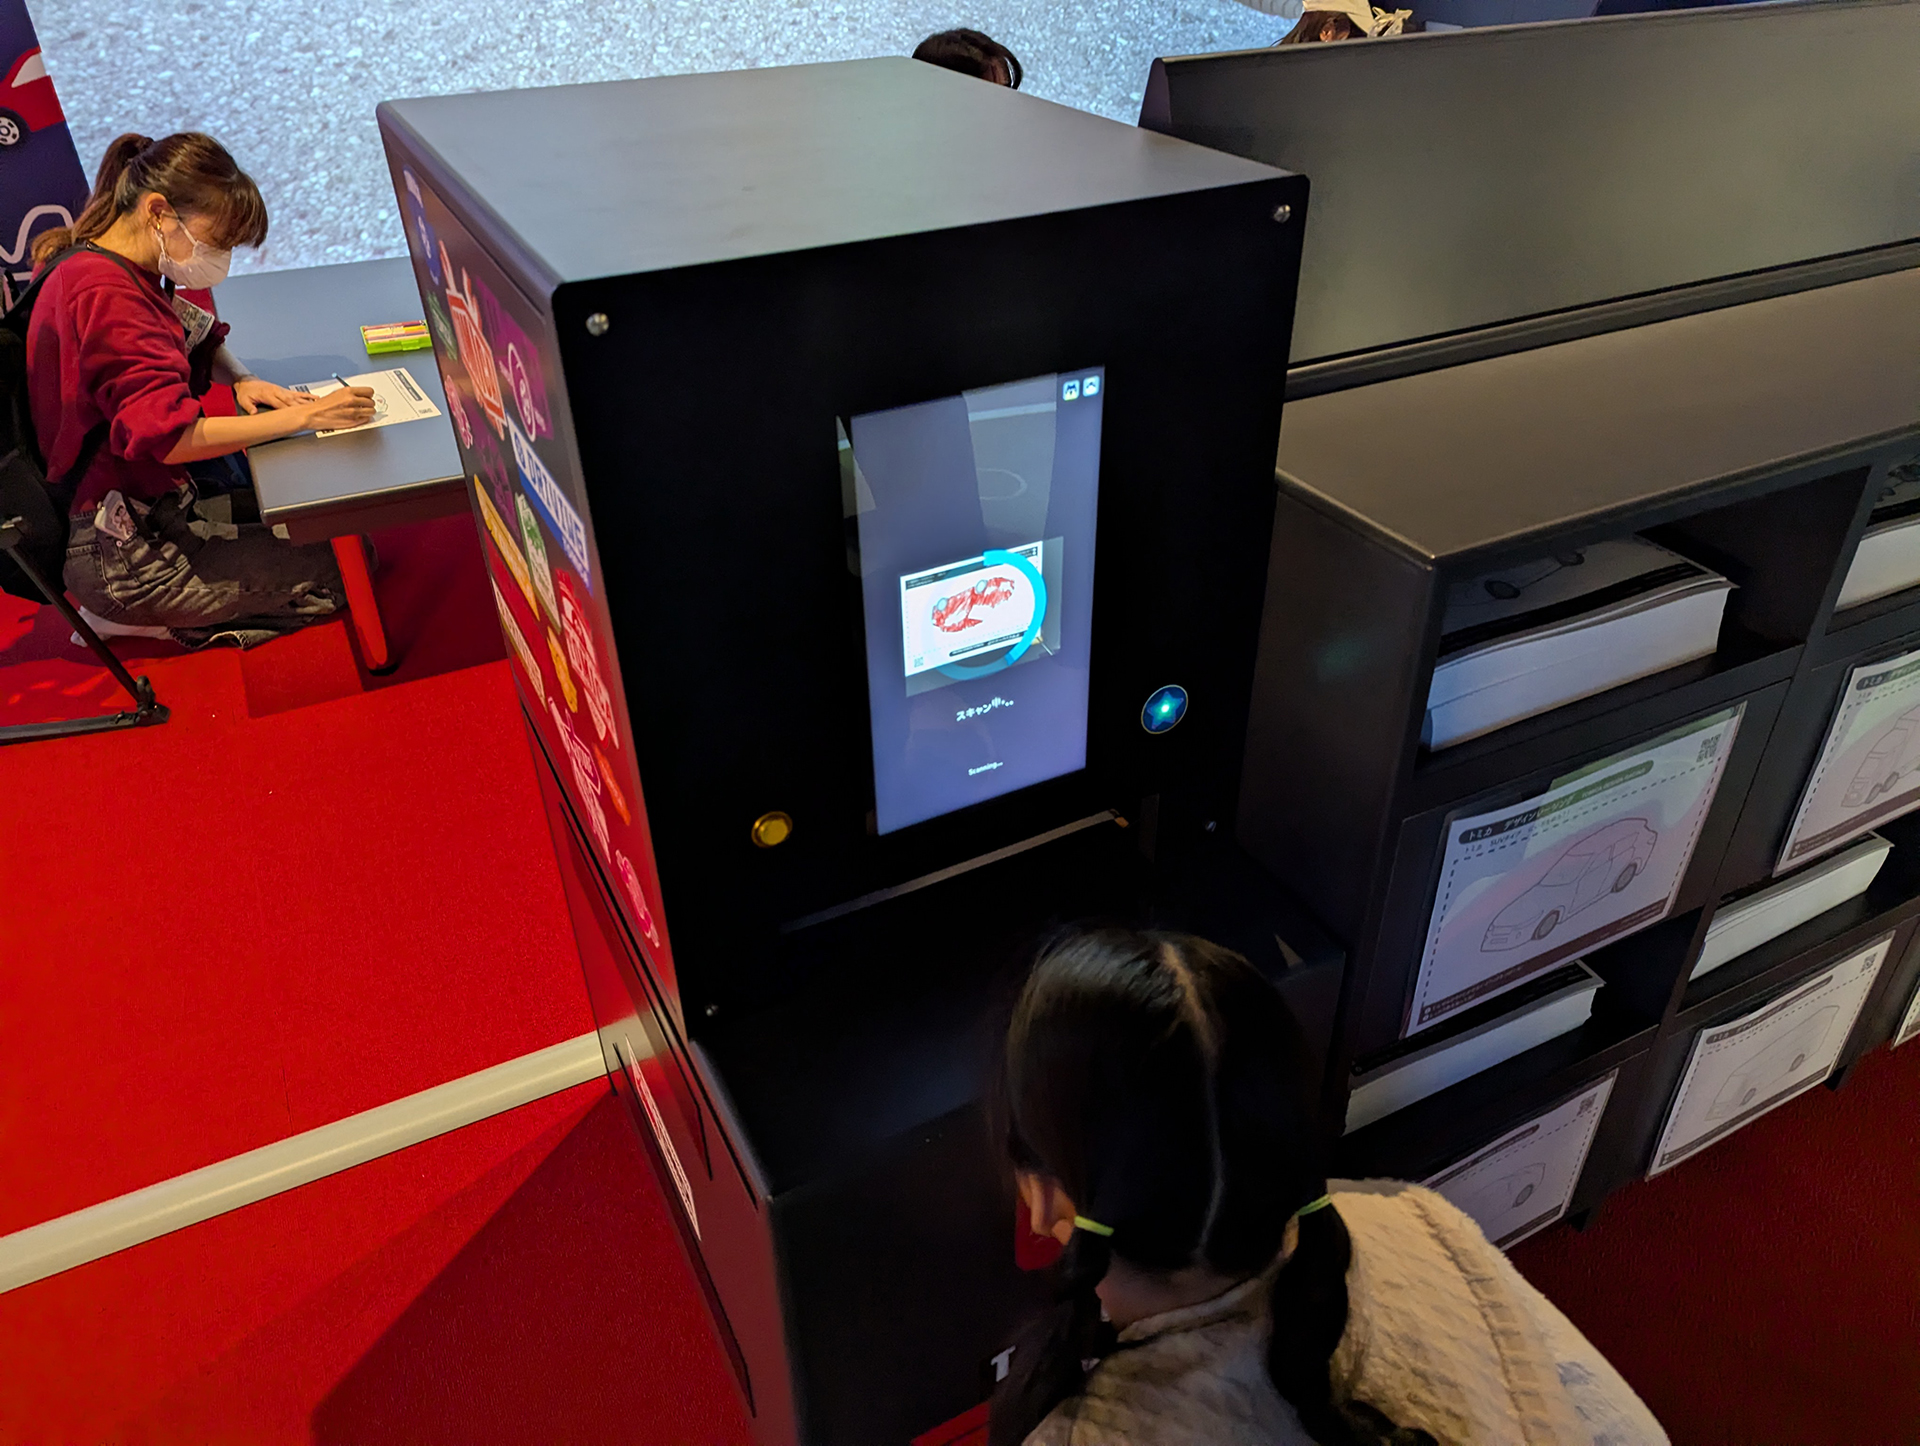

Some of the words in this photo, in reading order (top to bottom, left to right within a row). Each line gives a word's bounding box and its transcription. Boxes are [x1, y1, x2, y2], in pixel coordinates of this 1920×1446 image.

[566, 634, 614, 728] TOMICA
[1469, 827, 1492, 841] トミカ
